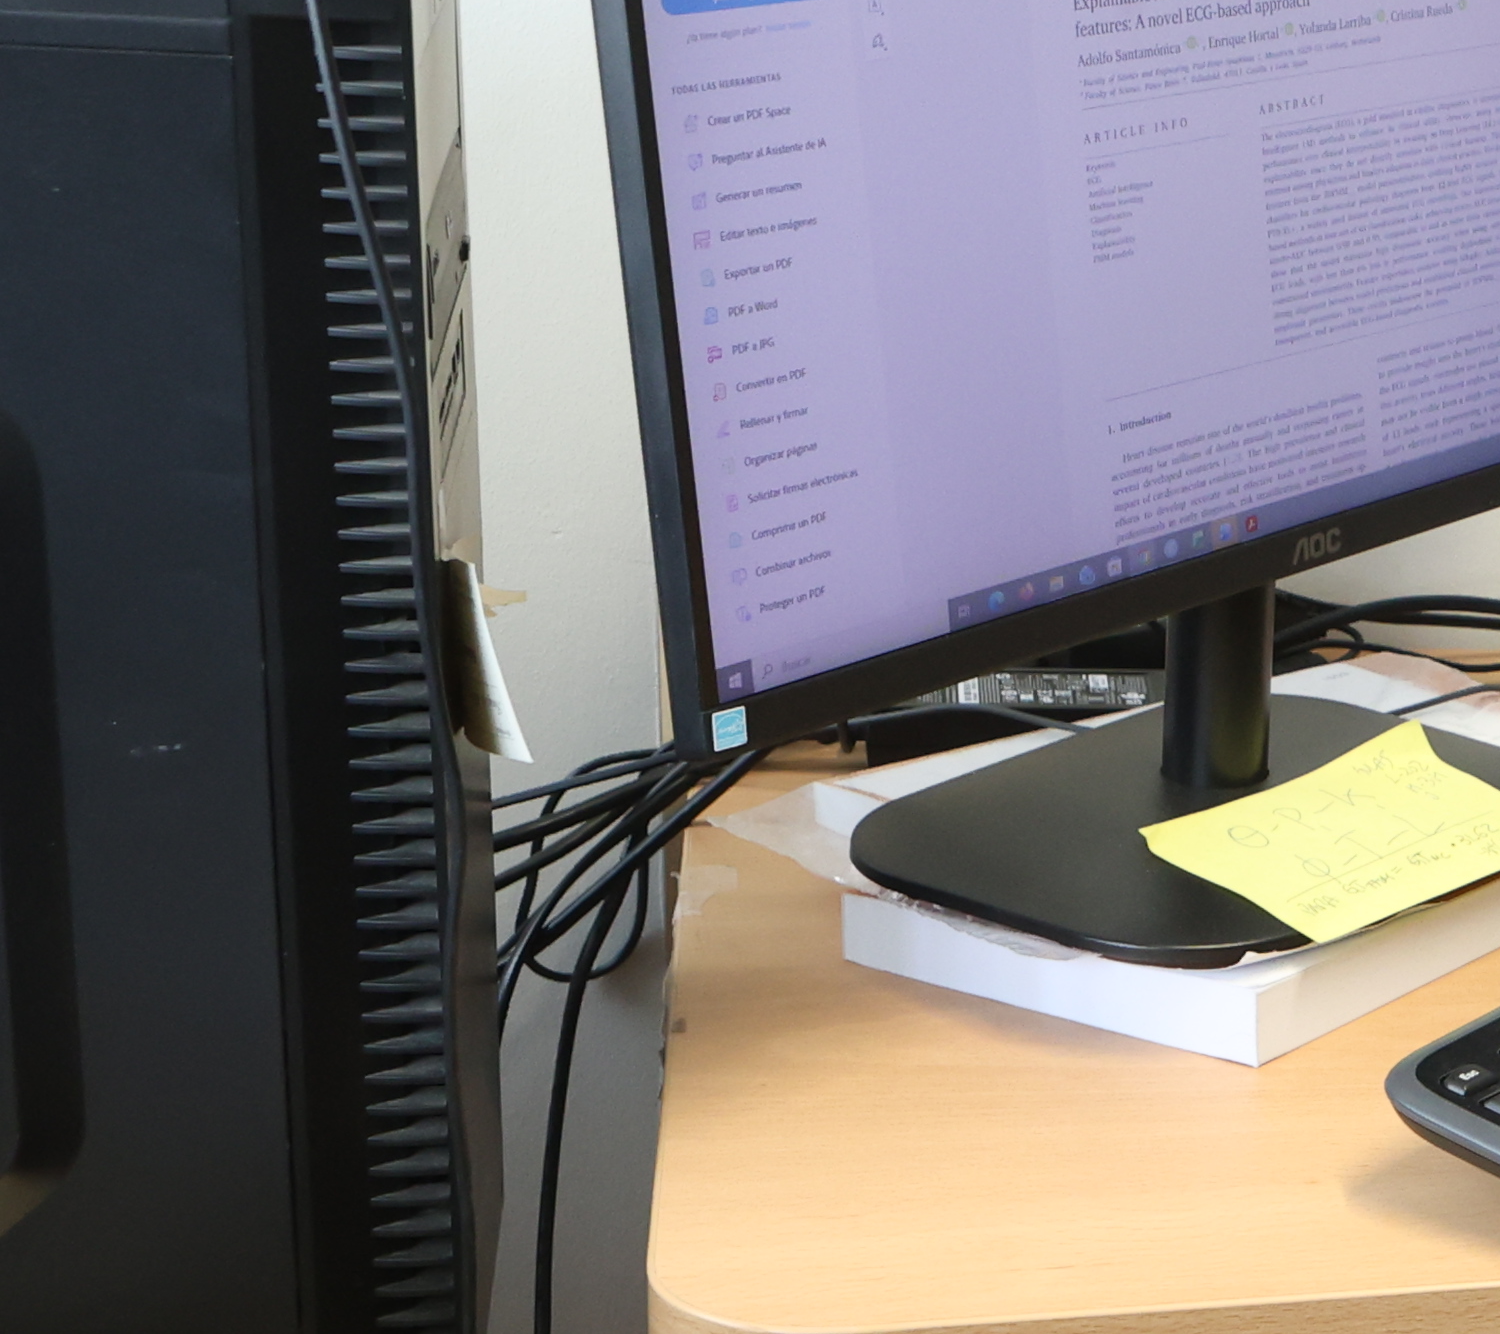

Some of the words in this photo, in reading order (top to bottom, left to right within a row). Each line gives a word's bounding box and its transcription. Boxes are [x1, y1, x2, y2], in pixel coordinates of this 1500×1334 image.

[1075, 15, 1133, 39] features:
[1135, 14, 1146, 30] A
[1148, 8, 1183, 28] novel
[1299, 20, 1337, 36] Yolanda
[1208, 33, 1247, 50] Enrique
[1249, 27, 1280, 43] Hortal
[1078, 53, 1113, 68] Adolfo
[672, 82, 698, 96] TODAS
[701, 80, 717, 92] LAS
[707, 114, 731, 127] Crear
[733, 114, 745, 124] un
[746, 108, 764, 122] PDF
[766, 105, 791, 119] Space
[1258, 93, 1325, 116] ABSTRACT
[724, 265, 760, 281] Exportar
[776, 257, 793, 271] PDF
[1119, 410, 1173, 433] Introduction
